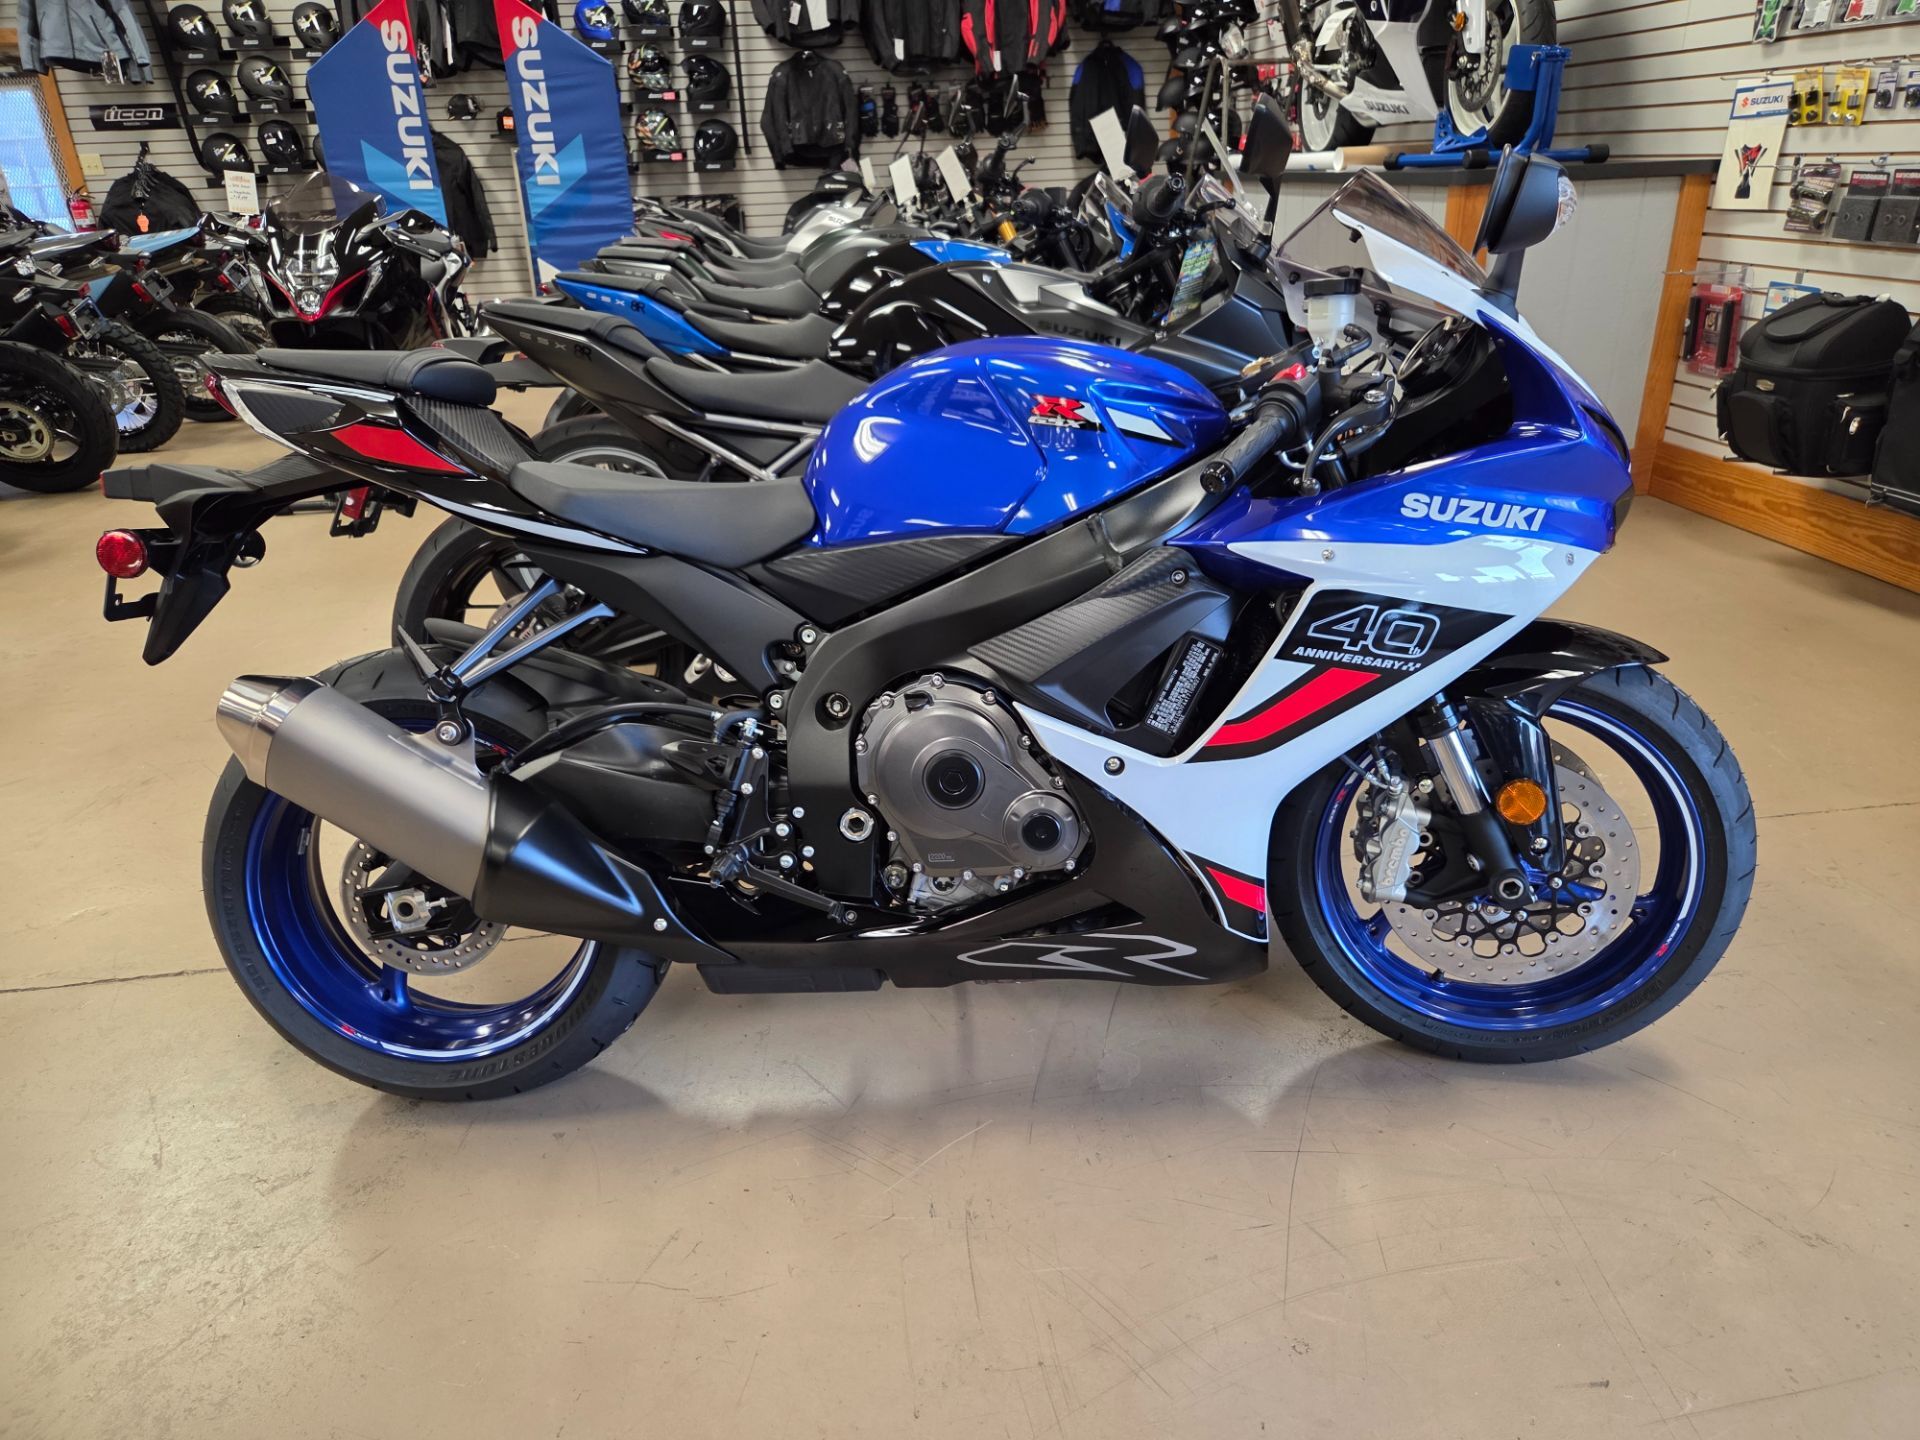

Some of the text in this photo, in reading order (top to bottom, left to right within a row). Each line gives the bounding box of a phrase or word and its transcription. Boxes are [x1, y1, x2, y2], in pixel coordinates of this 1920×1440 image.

[380, 19, 434, 190] SUZUKI
[511, 16, 561, 185] SUZUKI
[1363, 100, 1410, 115] SUZUKI
[1750, 95, 1784, 106] SUZUKI
[1400, 492, 1547, 533] SUZUKI
[1292, 646, 1405, 671] ANNIVERSARY
[1380, 828, 1409, 886] brembo
